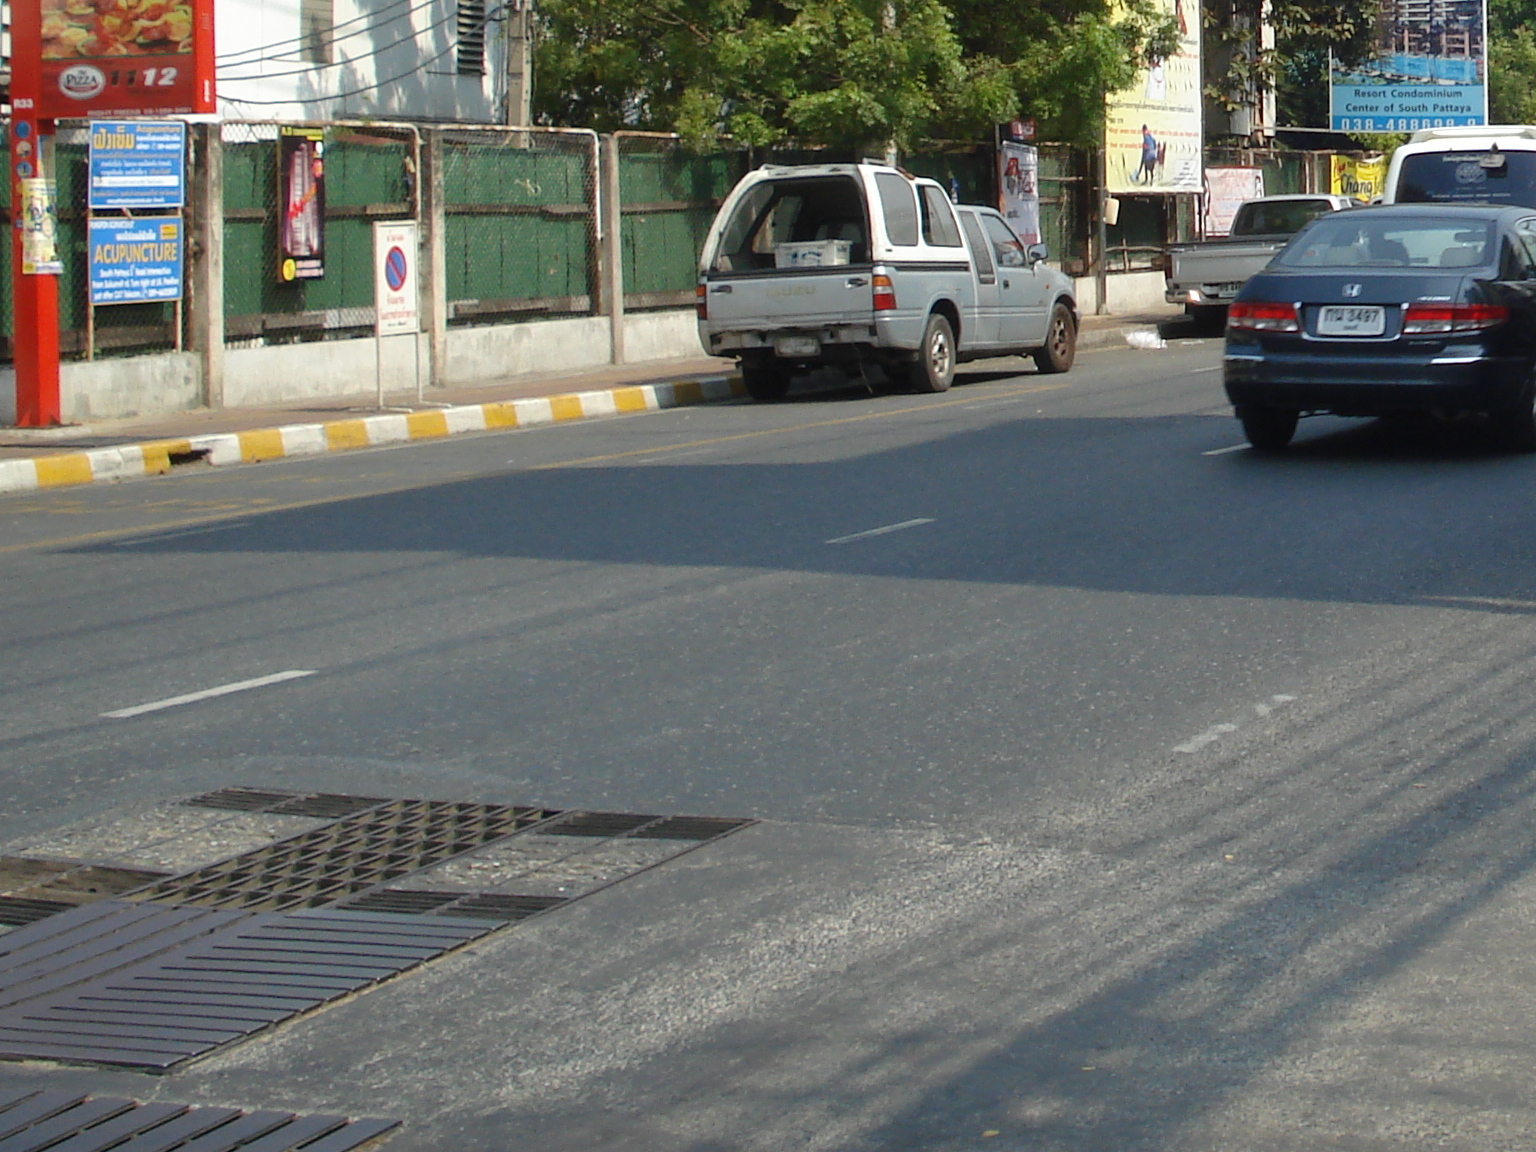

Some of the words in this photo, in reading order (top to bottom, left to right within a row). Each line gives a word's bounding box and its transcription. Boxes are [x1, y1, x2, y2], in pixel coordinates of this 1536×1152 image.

[66, 74, 97, 86] PIZZA
[1354, 88, 1386, 98] Resort
[1391, 88, 1463, 98] Condominium
[1345, 103, 1379, 112] Center
[1384, 103, 1394, 112] of
[1399, 103, 1428, 112] South
[1433, 103, 1472, 114] Pattaya
[1340, 173, 1373, 198] Chang
[94, 242, 178, 264] ACUPUNCTURE
